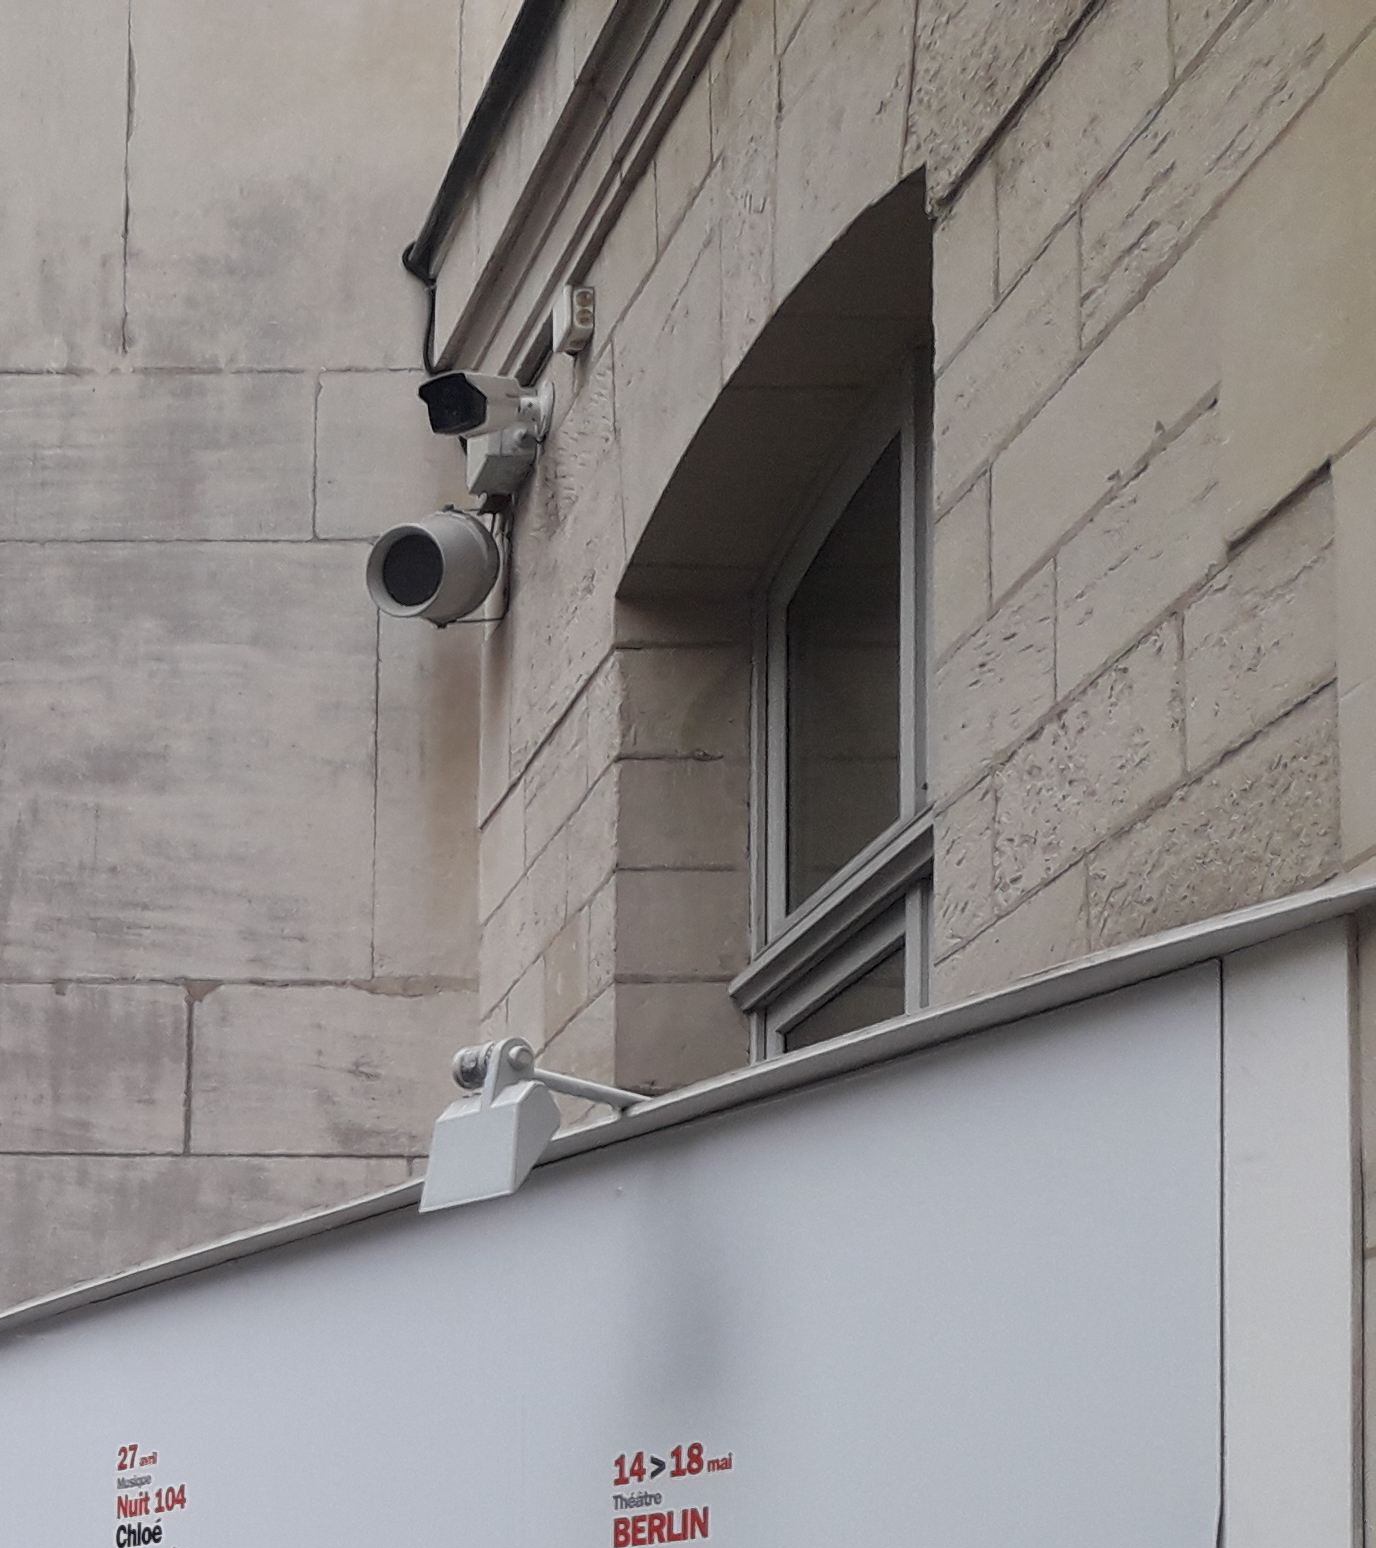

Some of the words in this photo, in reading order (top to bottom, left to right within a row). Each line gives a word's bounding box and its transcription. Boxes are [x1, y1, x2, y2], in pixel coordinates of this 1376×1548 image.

[117, 1444, 138, 1471] 27
[708, 1452, 733, 1472] mai
[117, 1491, 150, 1519] Nuit
[155, 1484, 186, 1513] 104
[612, 1491, 662, 1510] Théâtre
[116, 1518, 162, 1548] Chloé
[614, 1506, 709, 1548] BERLIN
